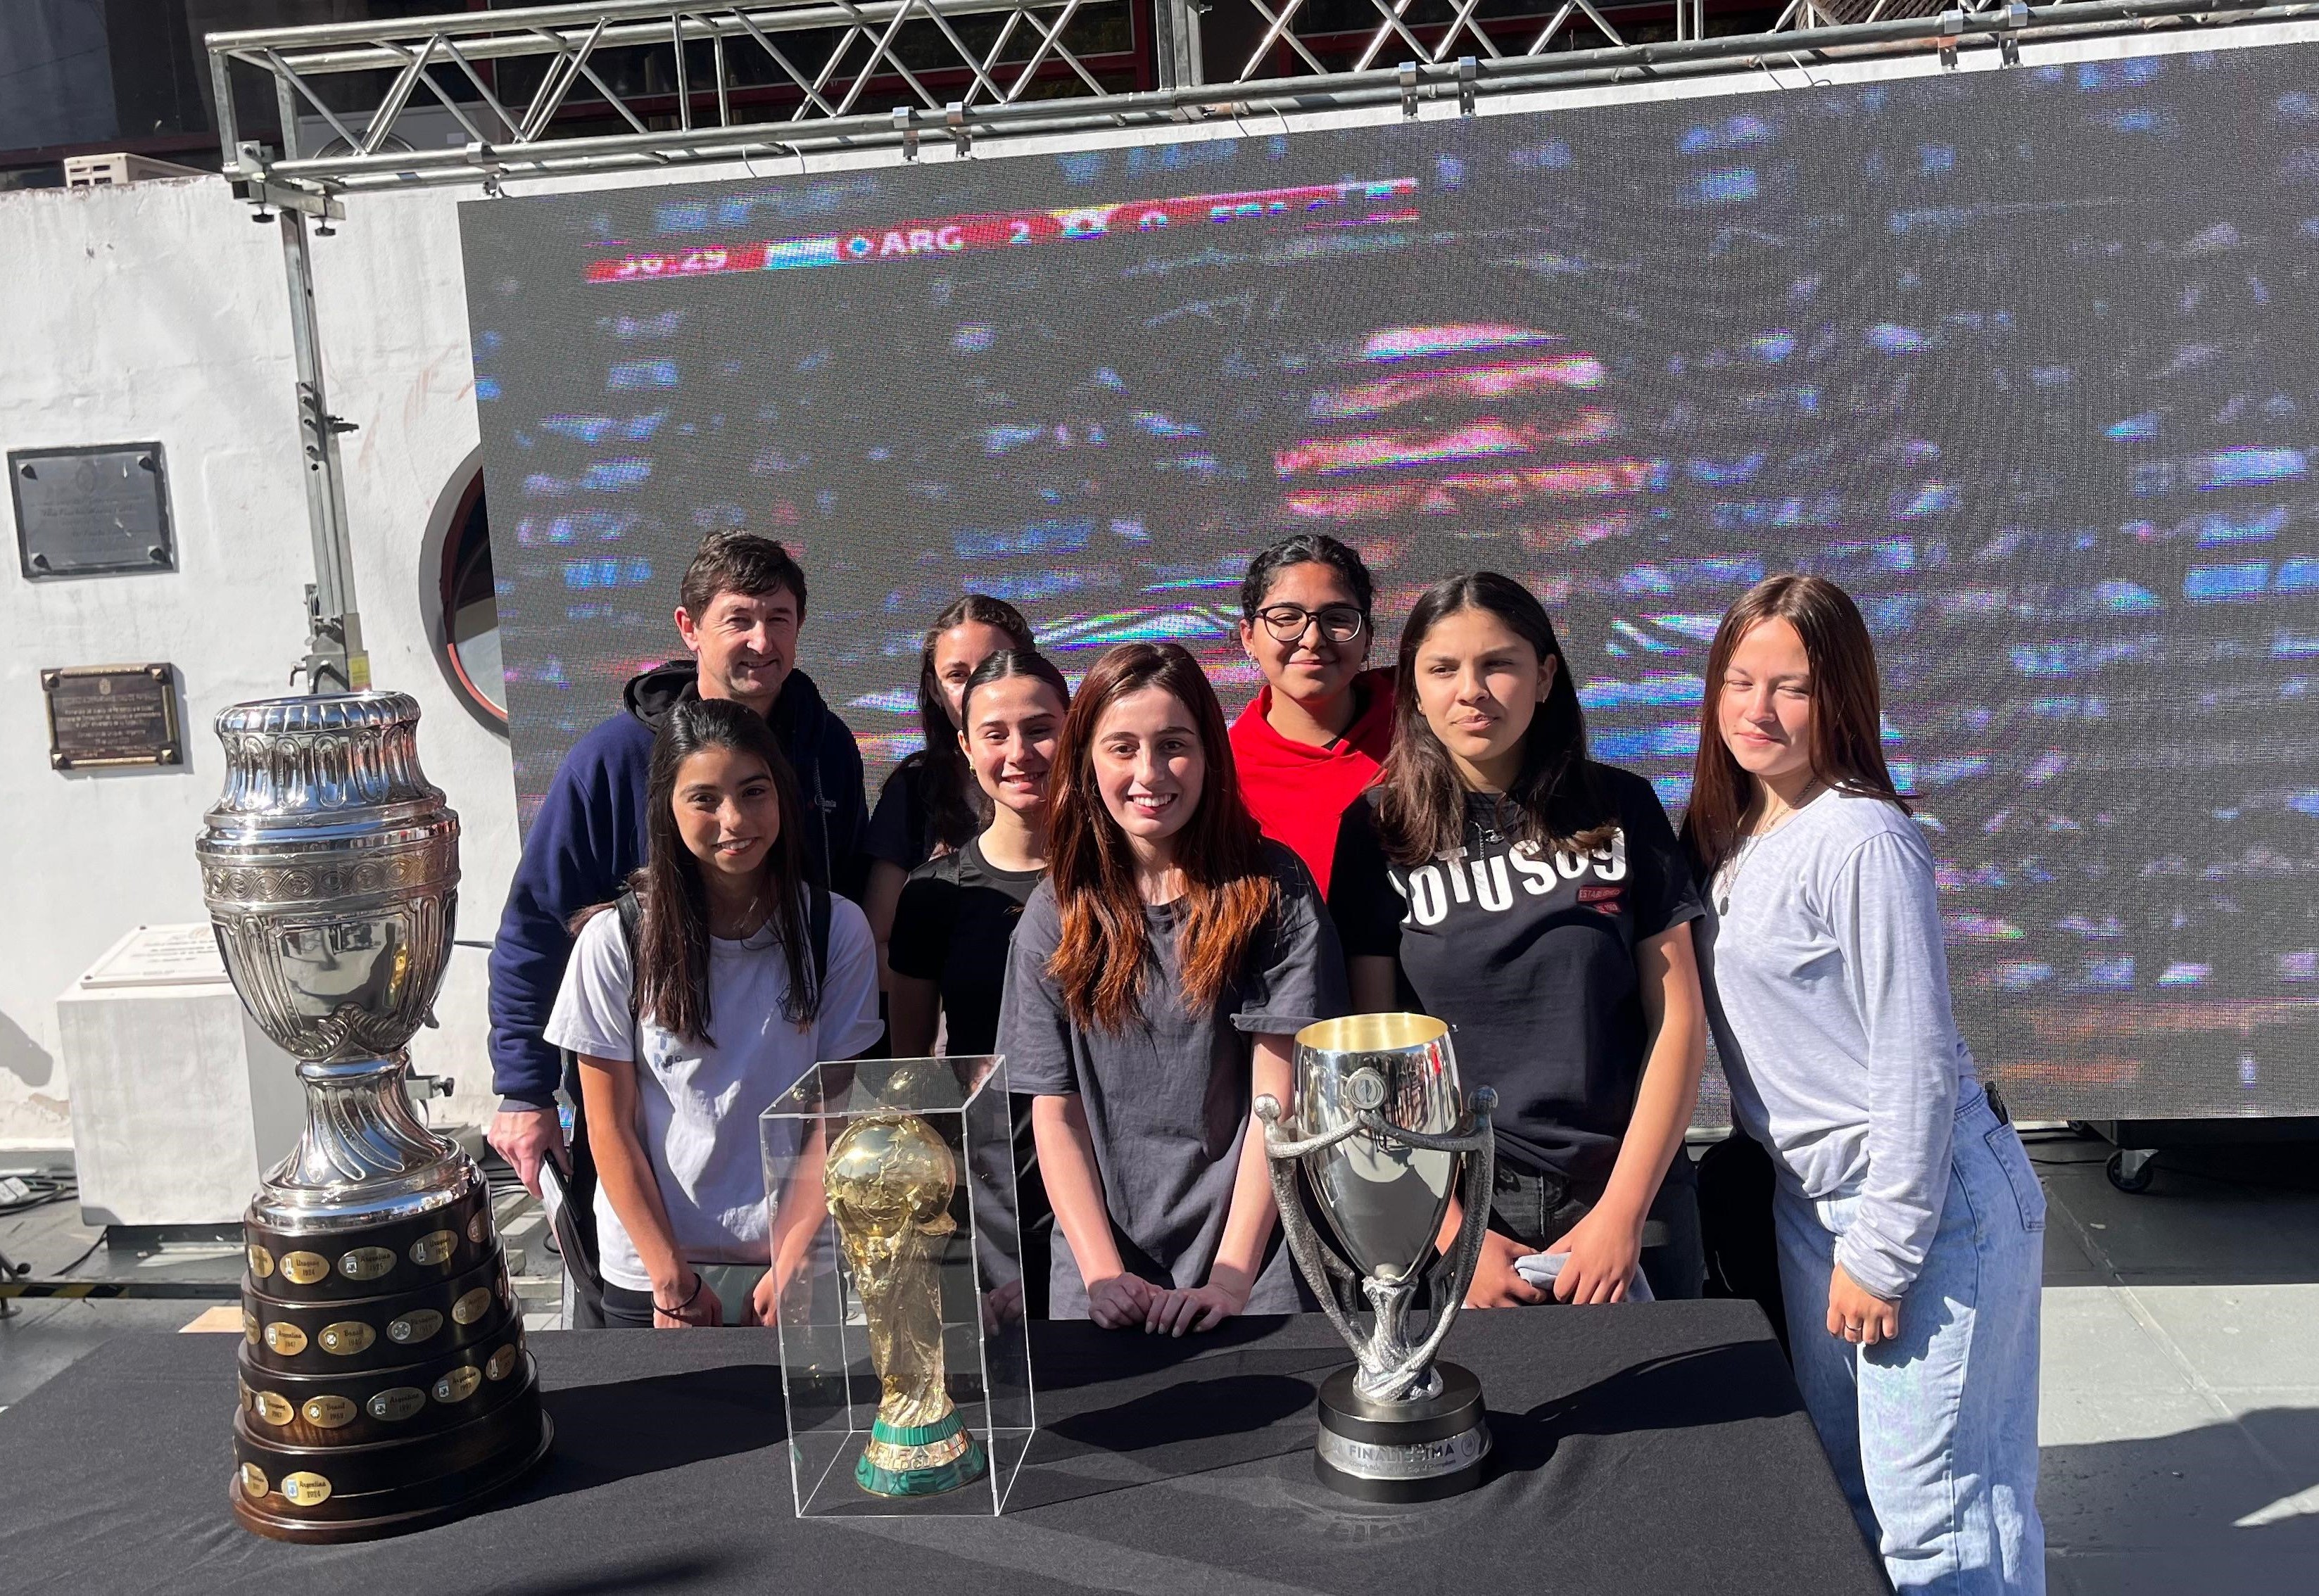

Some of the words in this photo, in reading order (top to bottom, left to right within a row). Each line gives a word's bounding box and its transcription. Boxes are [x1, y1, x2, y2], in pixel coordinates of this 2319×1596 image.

[880, 226, 964, 255] ARG
[1009, 220, 1030, 244] 2
[1386, 828, 1626, 925] OTUS09
[1579, 889, 1620, 898] ESTABSHED
